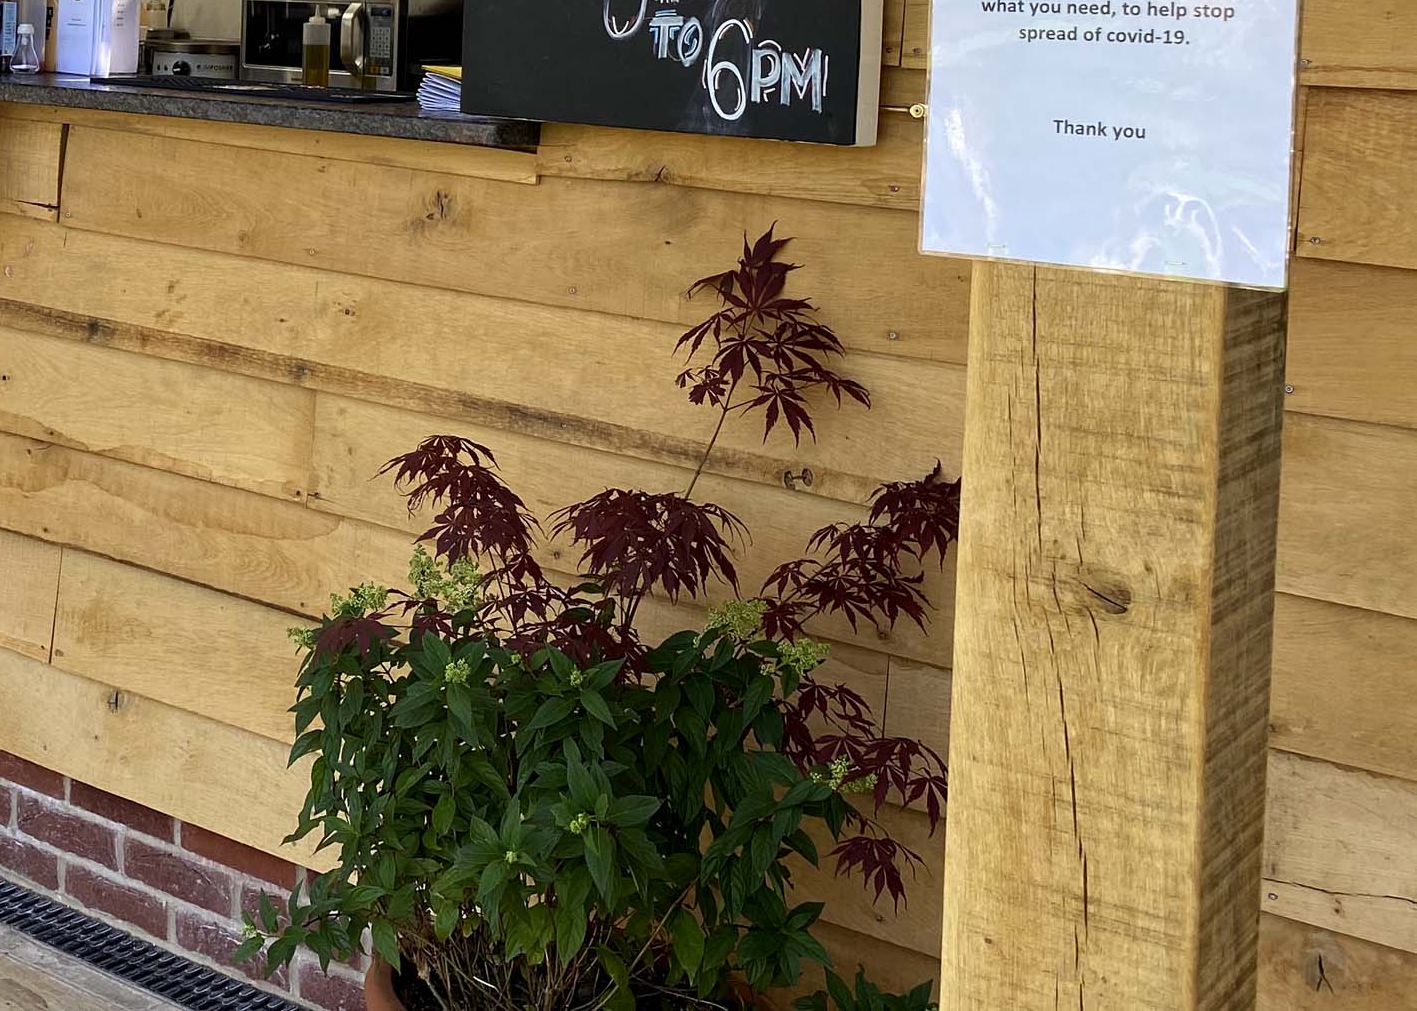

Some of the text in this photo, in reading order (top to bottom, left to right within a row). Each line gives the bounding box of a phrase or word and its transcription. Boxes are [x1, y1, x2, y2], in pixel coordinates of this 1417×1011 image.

[1030, 3, 1061, 17] you
[1067, 0, 1116, 17] need,
[1122, 3, 1141, 16] to
[1147, 1, 1187, 20] help
[1193, 5, 1235, 21] stop
[1019, 26, 1190, 45] spread of covid-19.
[650, 9, 829, 121] TO 6PM
[1053, 119, 1146, 141] Thank you
